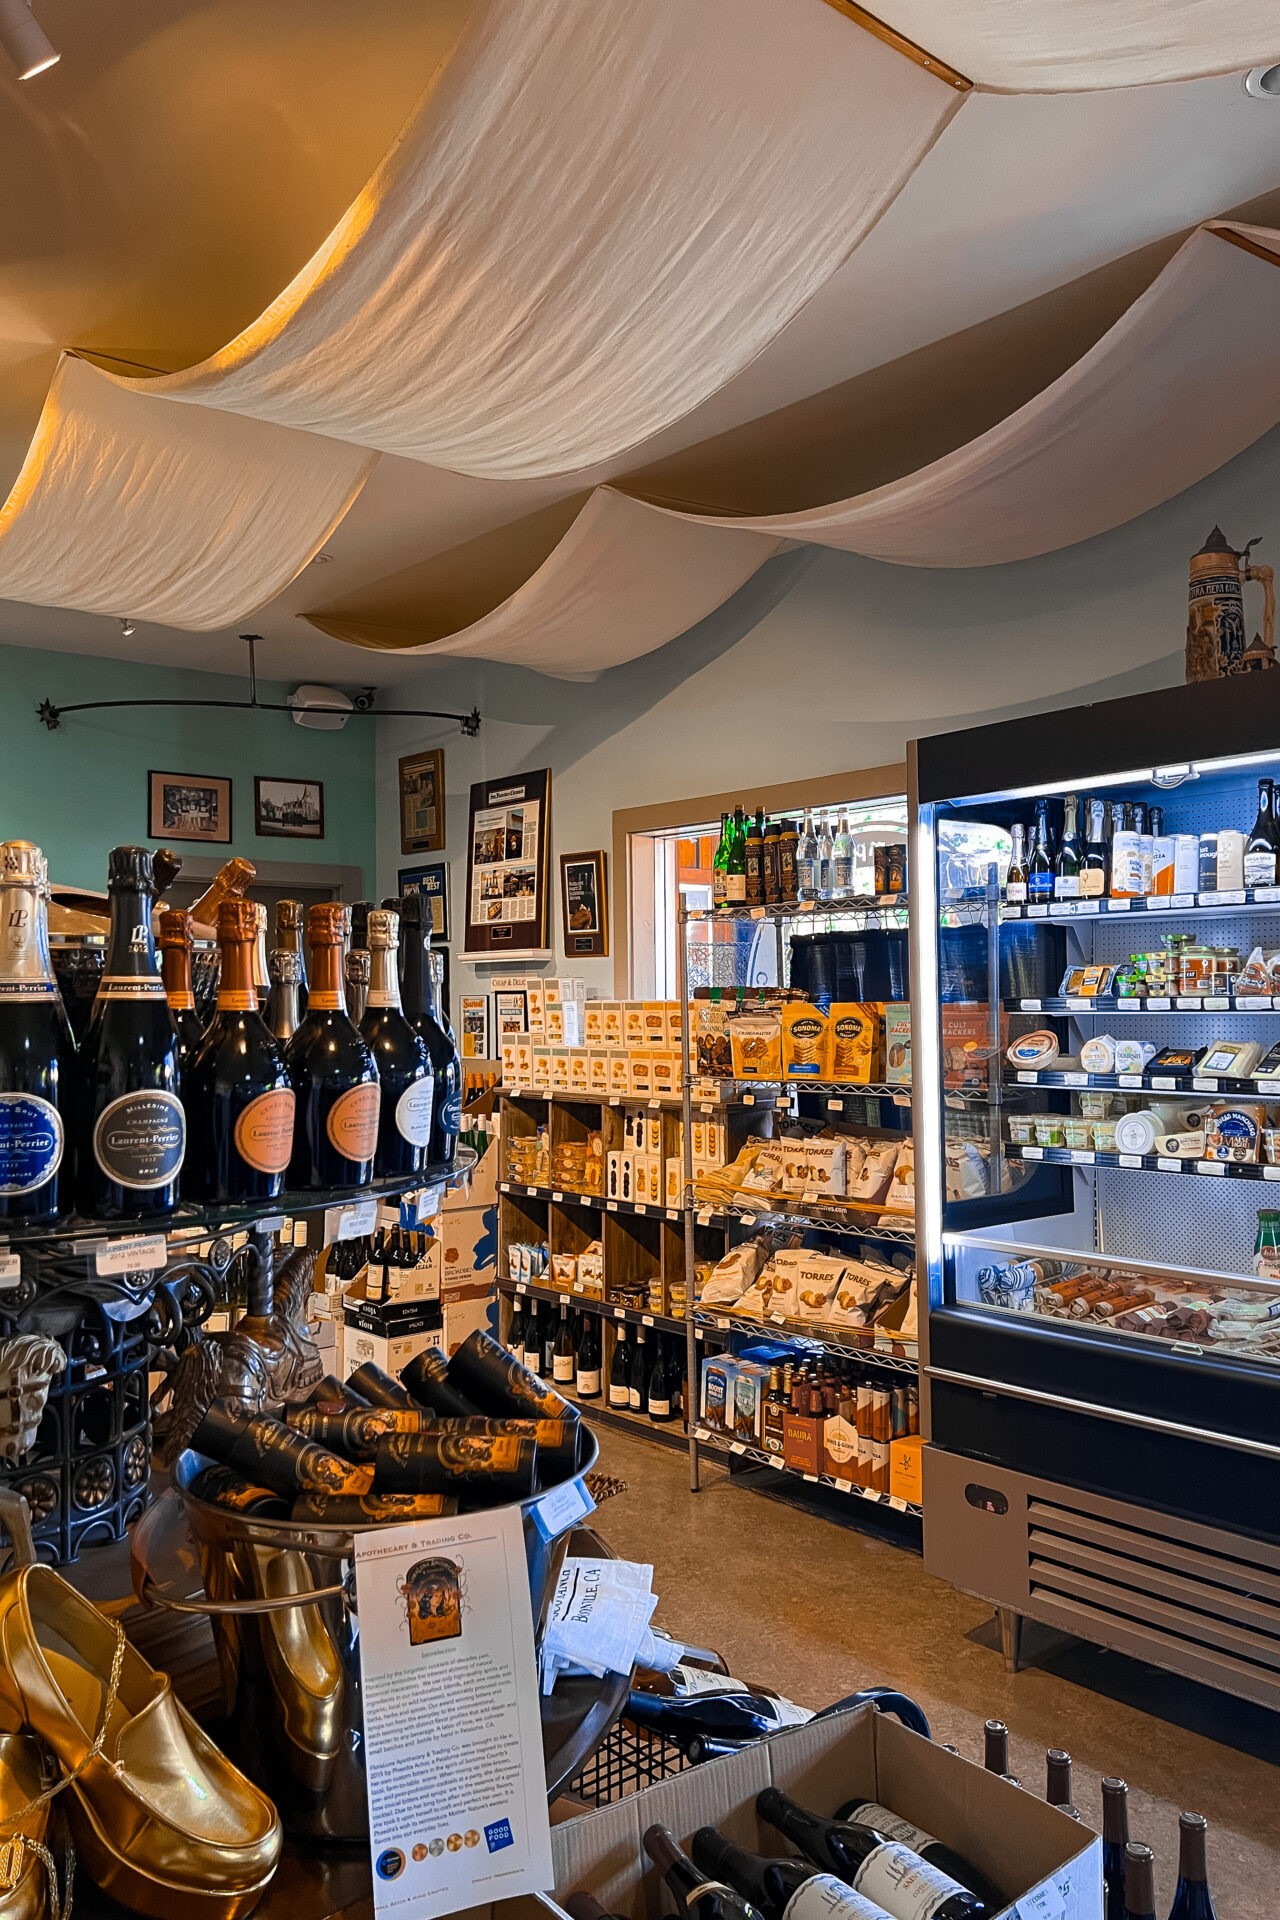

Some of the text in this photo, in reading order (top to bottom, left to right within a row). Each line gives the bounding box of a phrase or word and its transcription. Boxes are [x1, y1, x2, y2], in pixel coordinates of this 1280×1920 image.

[423, 875, 436, 885] BEST
[427, 881, 440, 891] BEST
[128, 944, 149, 953] 2012
[0, 983, 47, 992] rent-Perrier
[108, 982, 163, 992] Laurent-Perrie
[492, 979, 506, 987] CHEAP
[512, 978, 526, 986] DELIC
[793, 1025, 821, 1034] SONOMA
[836, 1025, 861, 1034] SONOMA
[1232, 1112, 1256, 1137] MANCHEGO
[0, 1139, 50, 1149] nt-Perrier
[111, 1133, 179, 1146] Laurent-Perrier
[783, 1145, 804, 1154] TORR
[805, 1148, 834, 1156] TORRES
[138, 1167, 158, 1175] BRUT
[127, 1248, 156, 1257] VINTAGE
[800, 1271, 834, 1281] TORRES
[845, 1271, 872, 1287] TORRES
[788, 1428, 812, 1441] DAURA
[356, 1543, 409, 1559] APOTHECARY
[420, 1535, 456, 1548] TRADING
[583, 1568, 601, 1583] CA
[421, 1647, 456, 1658] Introduction
[369, 1758, 395, 1769] FloraLuna
[395, 1751, 425, 1765] Apothecary
[431, 1746, 451, 1757] Trading
[499, 1733, 507, 1741] life
[370, 1769, 383, 1778] 2015
[391, 1763, 413, 1773] Phaedra
[435, 1752, 459, 1763] Petaluma
[476, 1744, 497, 1756] inspired
[503, 1739, 519, 1748] create
[411, 1767, 429, 1777] bitters
[444, 1761, 458, 1771] spirit
[464, 1755, 485, 1765] Sonoma
[485, 1750, 508, 1762] County's
[370, 1785, 385, 1796] local,
[385, 1777, 420, 1791] farm-to-table
[438, 1770, 454, 1779] When
[454, 1765, 473, 1777] mixing
[394, 1782, 436, 1799] post-prohibition
[435, 1777, 458, 1788] cocktails
[468, 1771, 483, 1782] party,
[493, 1762, 521, 1774] discovered
[401, 1795, 418, 1804] bitters
[505, 1771, 520, 1782] good
[372, 1809, 393, 1819] cocktail.
[422, 1799, 435, 1809] long
[435, 1797, 447, 1805] love
[447, 1793, 460, 1802] affair
[460, 1791, 472, 1799] with
[472, 1785, 496, 1798] blending
[495, 1781, 514, 1792] flavors,
[383, 1817, 395, 1825] took
[401, 1814, 415, 1823] upon
[415, 1808, 433, 1818] herself
[439, 1804, 452, 1812] craft
[463, 1797, 482, 1808] perfect
[488, 1825, 509, 1836] GOOD
[489, 1832, 510, 1842] FOOD
